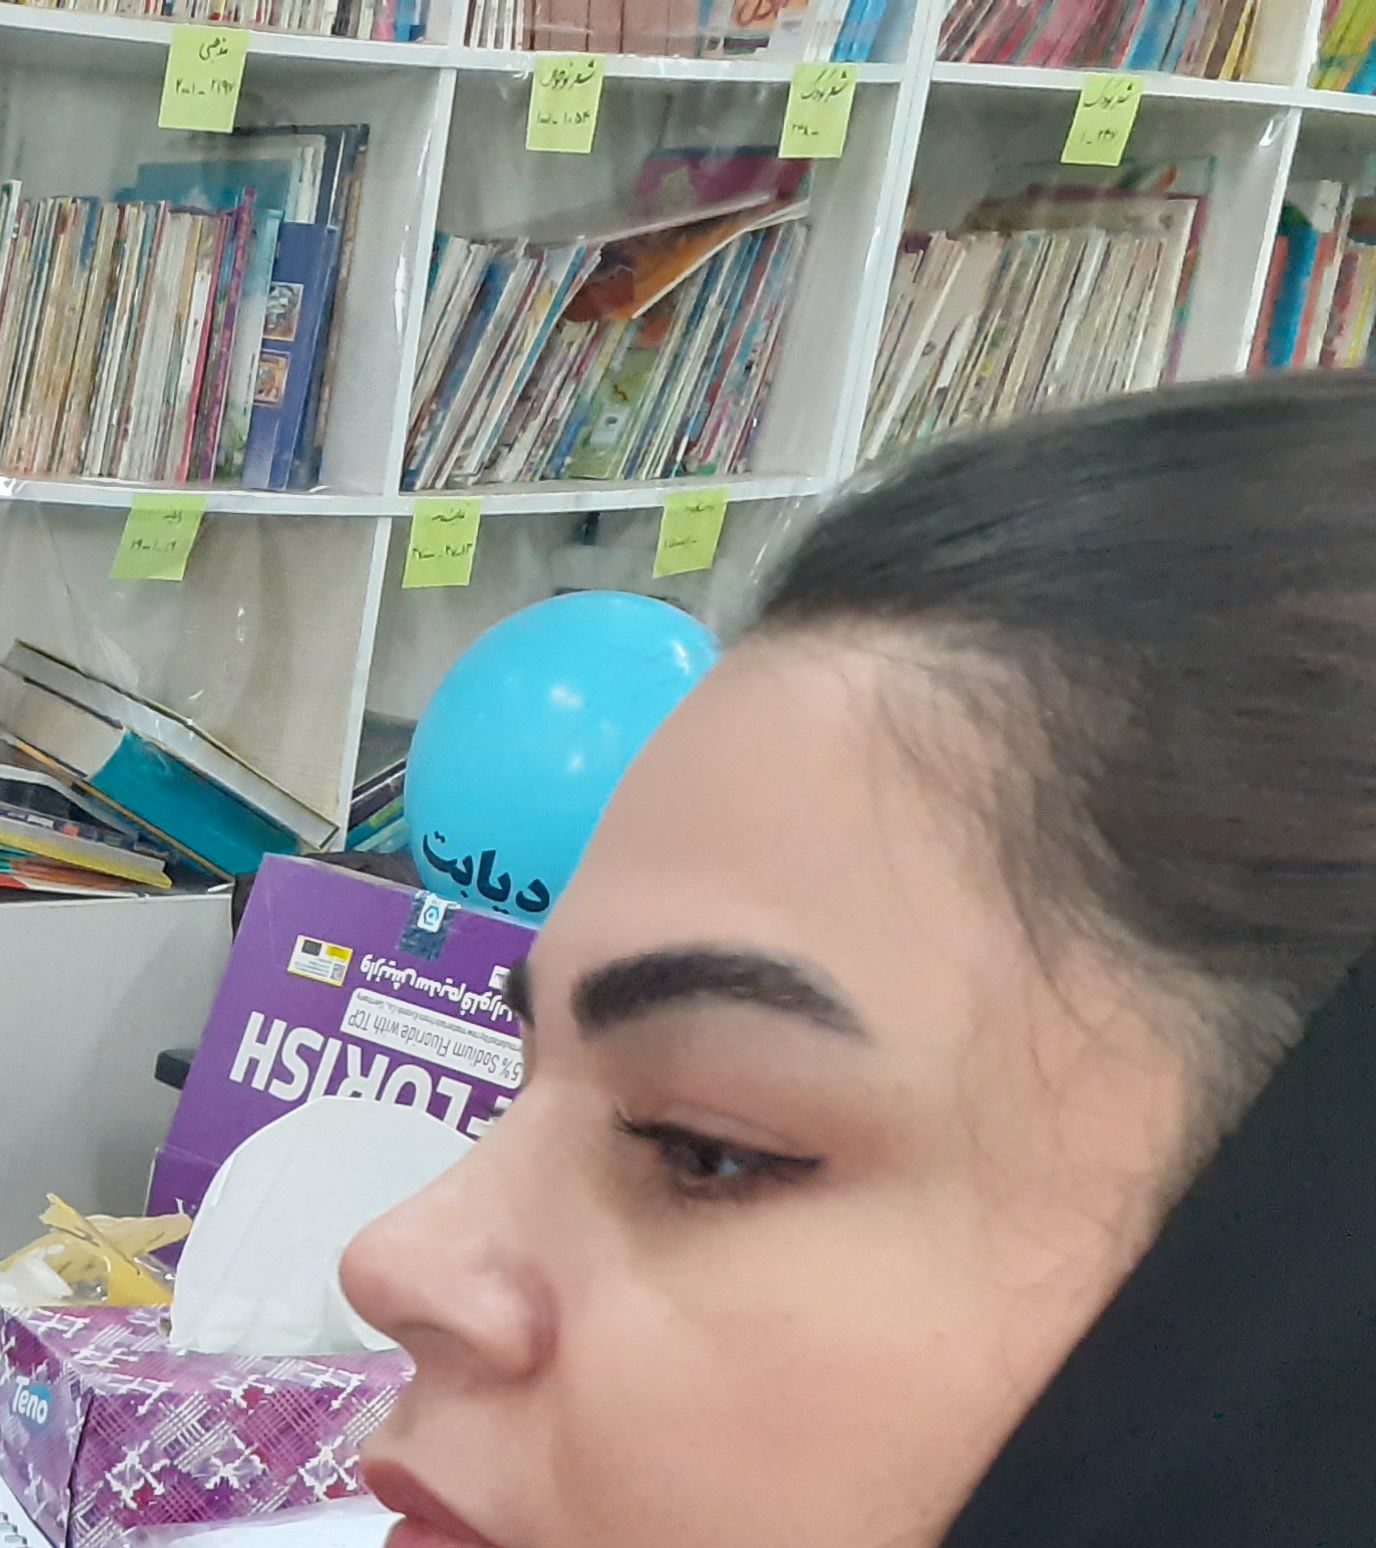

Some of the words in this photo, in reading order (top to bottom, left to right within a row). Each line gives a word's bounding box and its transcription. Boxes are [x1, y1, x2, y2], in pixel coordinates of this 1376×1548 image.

[423, 832, 550, 914] دیابت
[346, 1007, 371, 1031] TCP
[371, 1015, 400, 1039] with
[397, 1024, 450, 1057] Fluoride
[450, 1041, 500, 1074] Sodium
[11, 1375, 50, 1425] Teno
